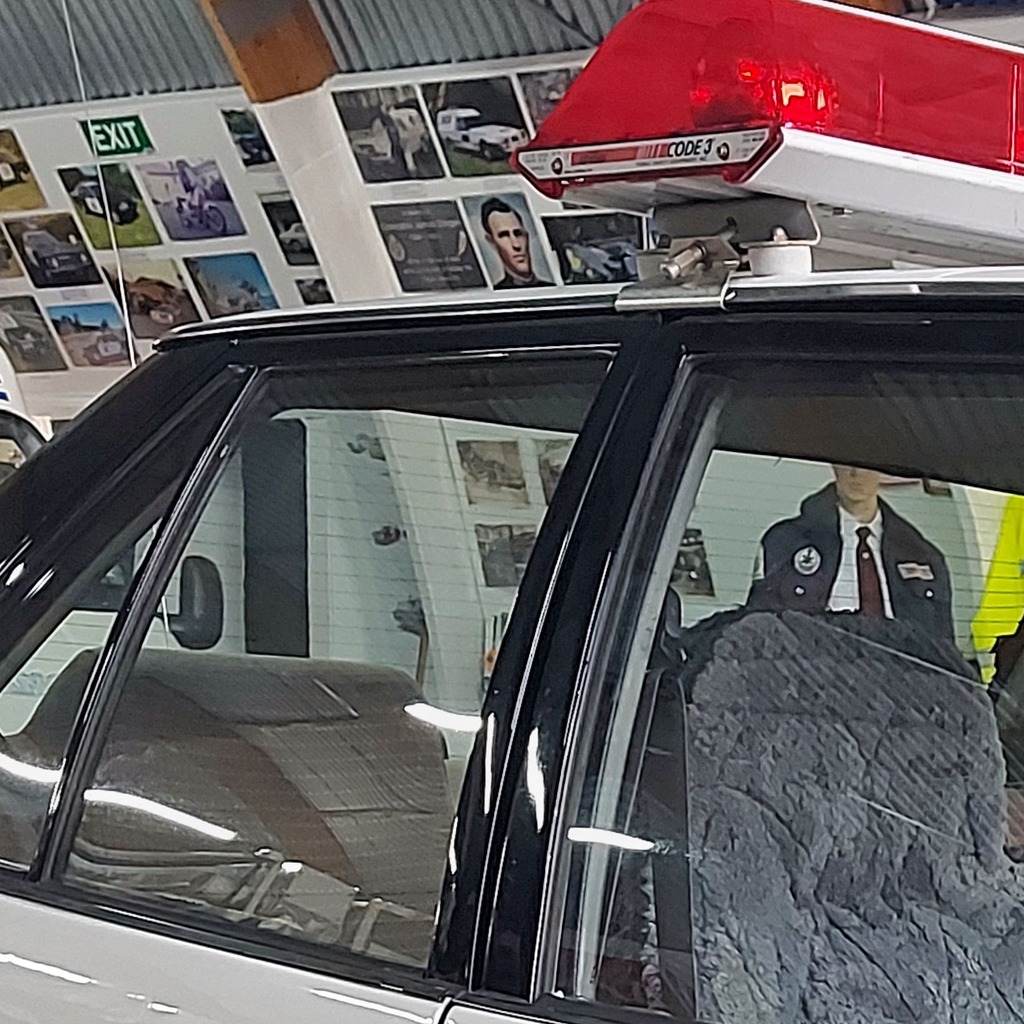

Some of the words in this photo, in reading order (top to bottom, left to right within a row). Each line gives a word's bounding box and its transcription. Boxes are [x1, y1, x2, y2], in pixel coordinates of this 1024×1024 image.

[92, 121, 141, 151] EXIT
[667, 139, 703, 158] CODE
[703, 138, 713, 155] 3
